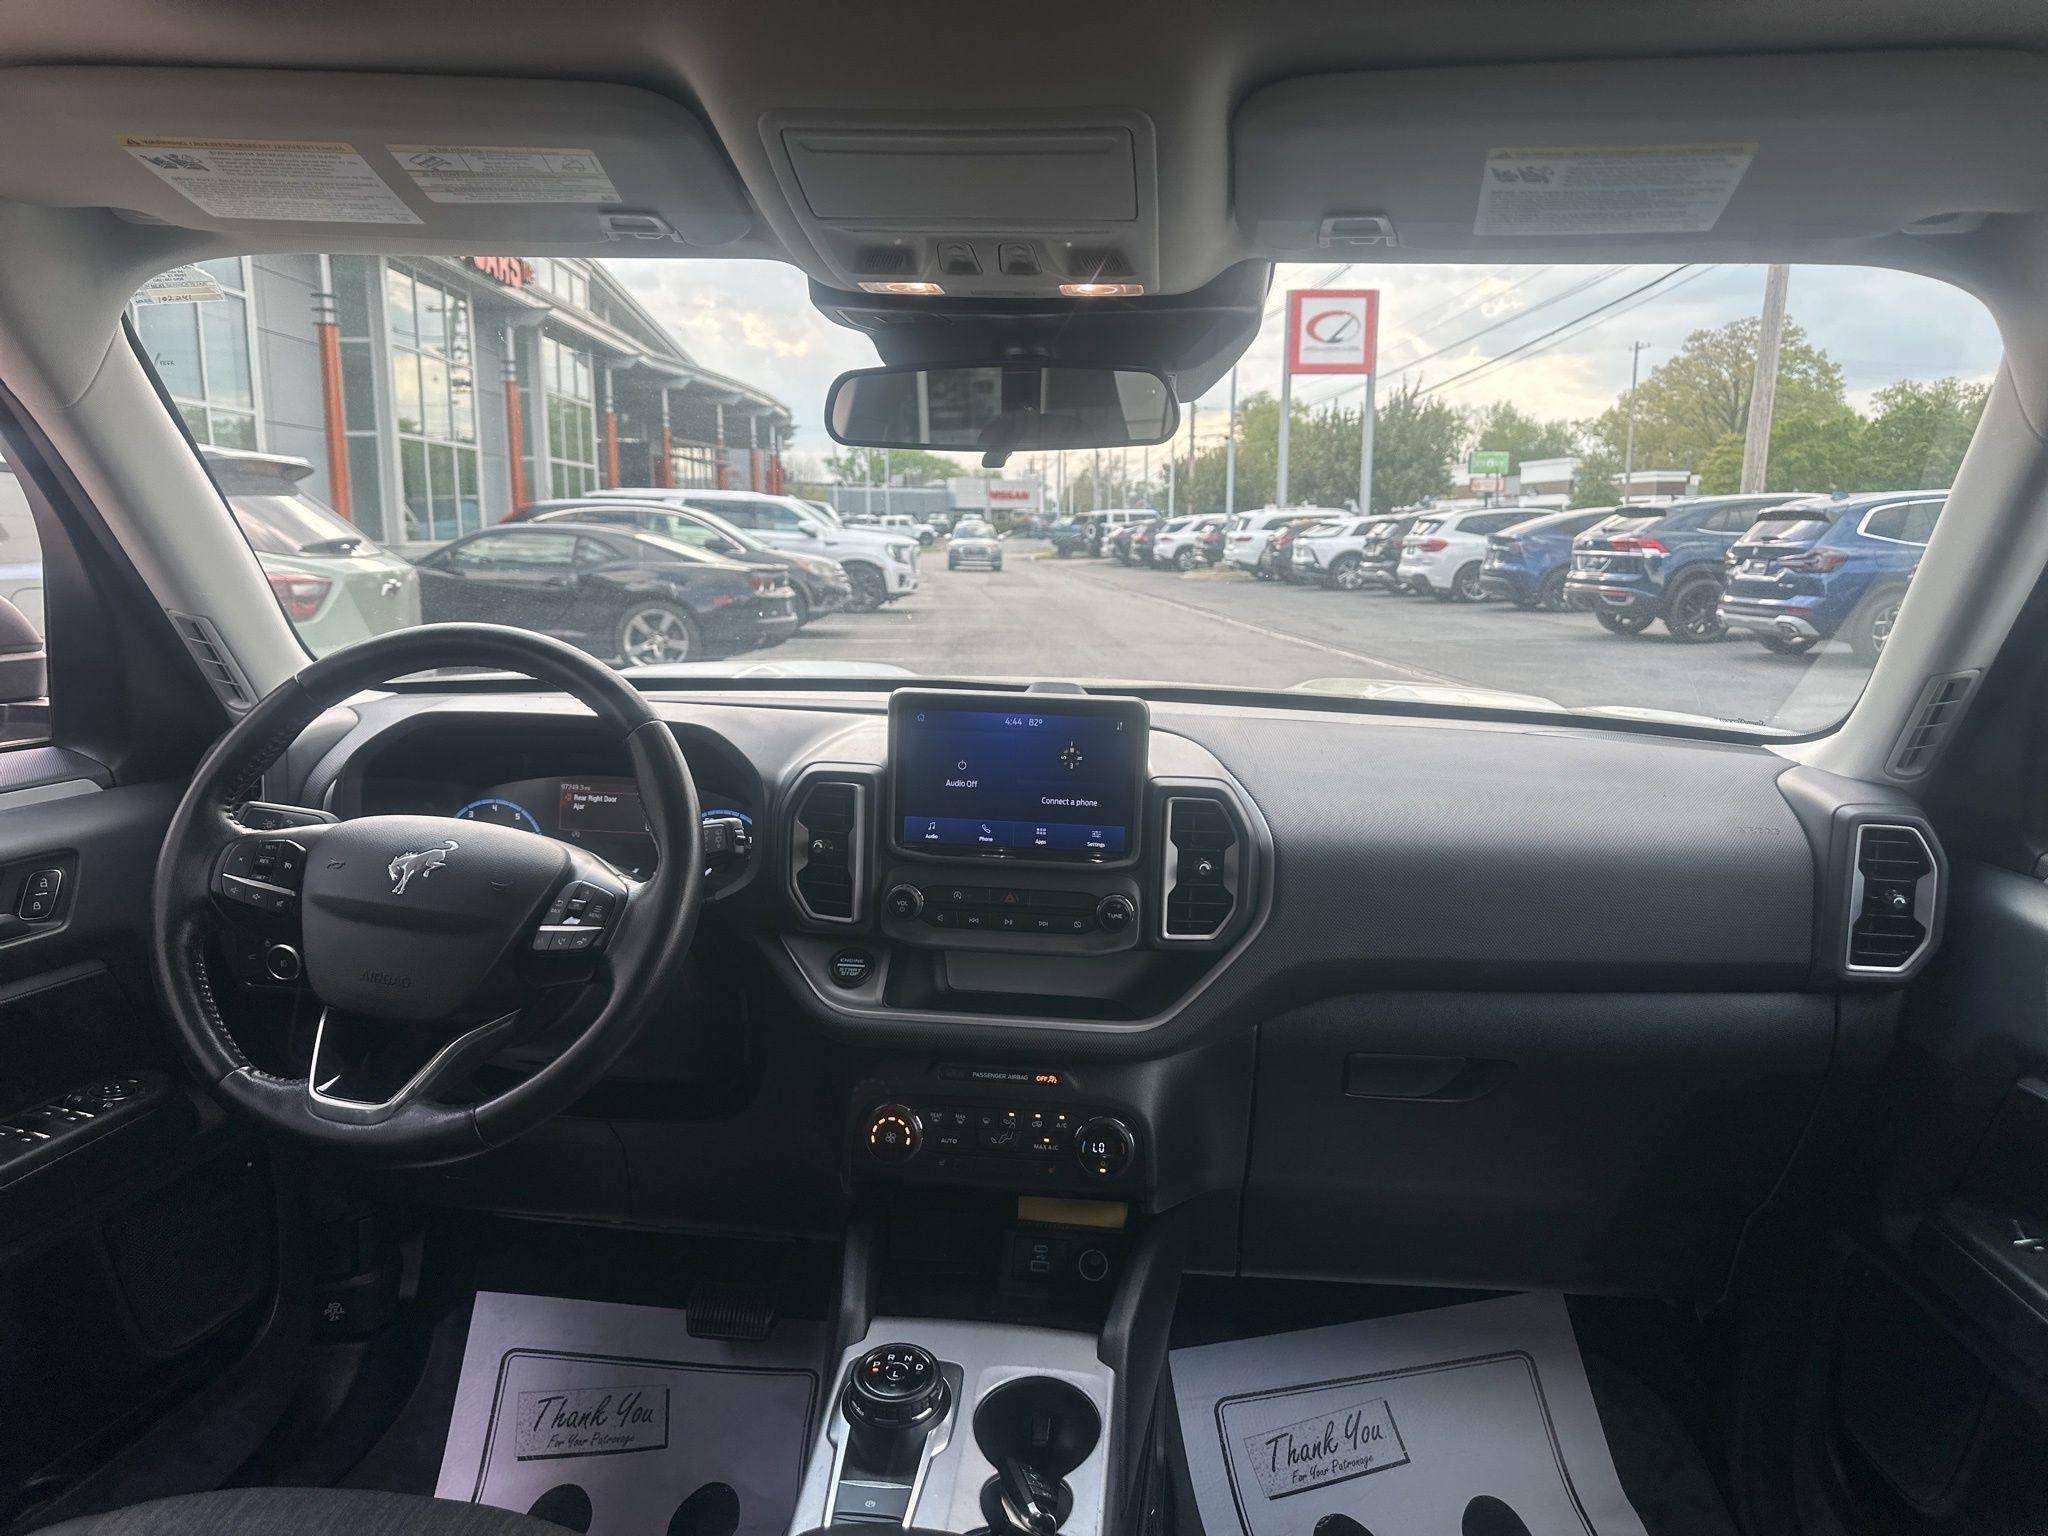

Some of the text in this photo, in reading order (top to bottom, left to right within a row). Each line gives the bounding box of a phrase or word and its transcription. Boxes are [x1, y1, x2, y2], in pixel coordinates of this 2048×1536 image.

[990, 490, 1030, 500] NISSAN
[1004, 717, 1023, 727] 4:44
[945, 779, 978, 788] Audio Off
[573, 793, 617, 803] Rear Right Door
[1041, 796, 1070, 806] Connect
[1076, 798, 1098, 808] phone
[491, 804, 498, 812] 4
[572, 803, 585, 811] Ajar
[514, 812, 521, 821] 5
[1086, 841, 1106, 849] Settings
[972, 1071, 1007, 1080] PASSENGER
[1008, 1073, 1029, 1081] AIRBAG
[1092, 1142, 1105, 1153] LO
[915, 1363, 924, 1371] D
[892, 1370, 899, 1378] L
[533, 1391, 654, 1432] Thank You
[546, 1431, 636, 1449] For Your Patronage
[1264, 1409, 1384, 1472] Thank You
[1291, 1454, 1374, 1484] For Your Patronage
